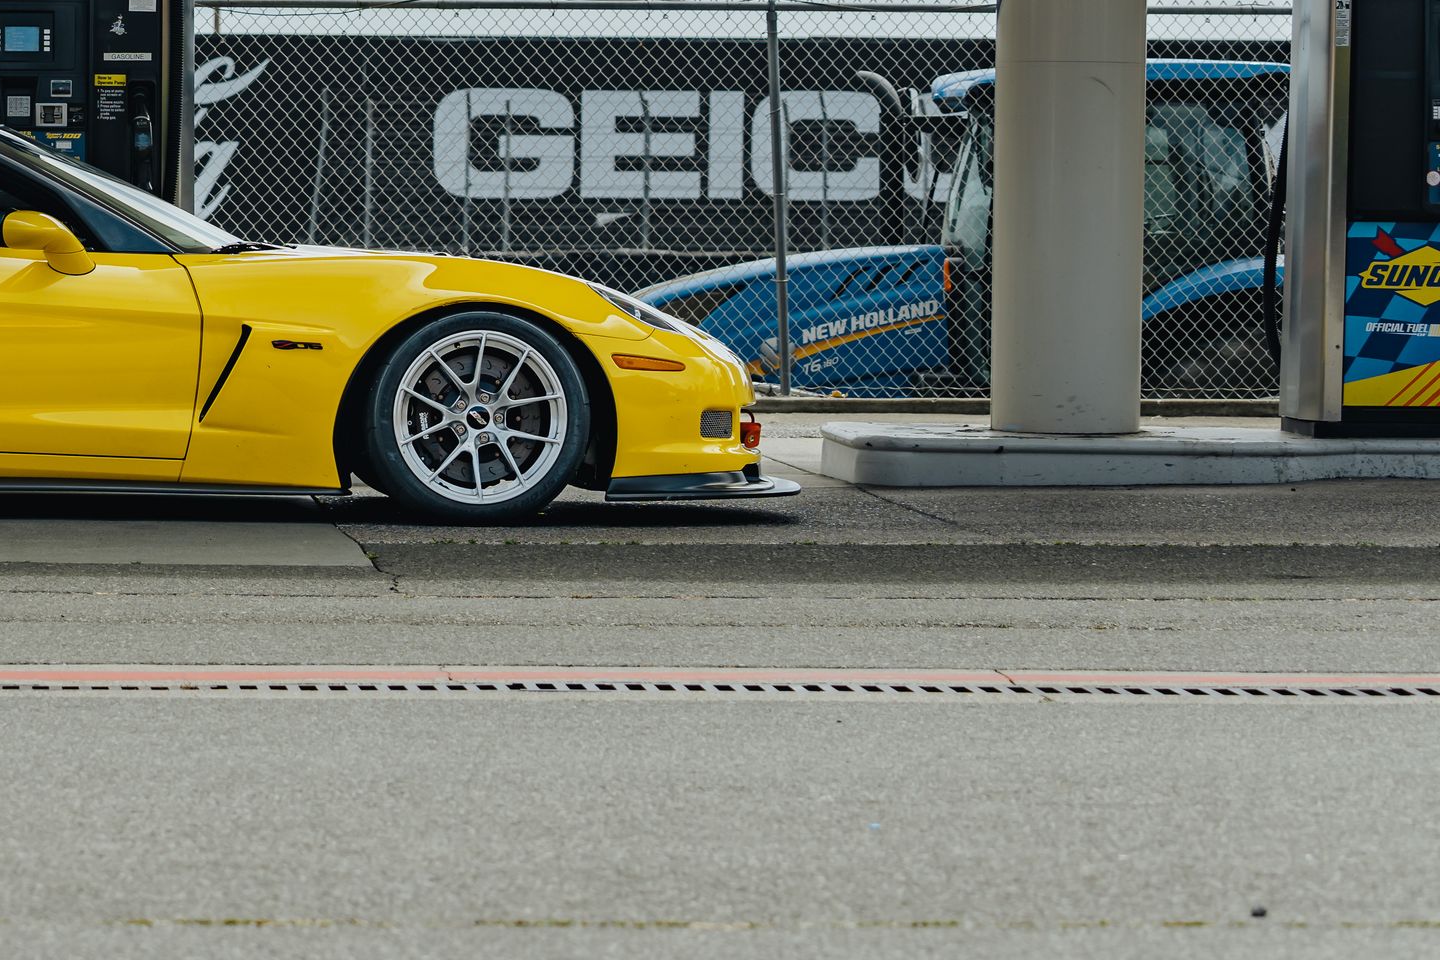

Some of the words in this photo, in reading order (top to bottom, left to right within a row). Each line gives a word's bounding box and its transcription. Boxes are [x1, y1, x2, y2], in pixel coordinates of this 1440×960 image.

[802, 318, 847, 344] NEW
[850, 300, 939, 332] HOLLAND
[1365, 322, 1404, 333] OFFICIAL
[1406, 323, 1428, 333] FUEL
